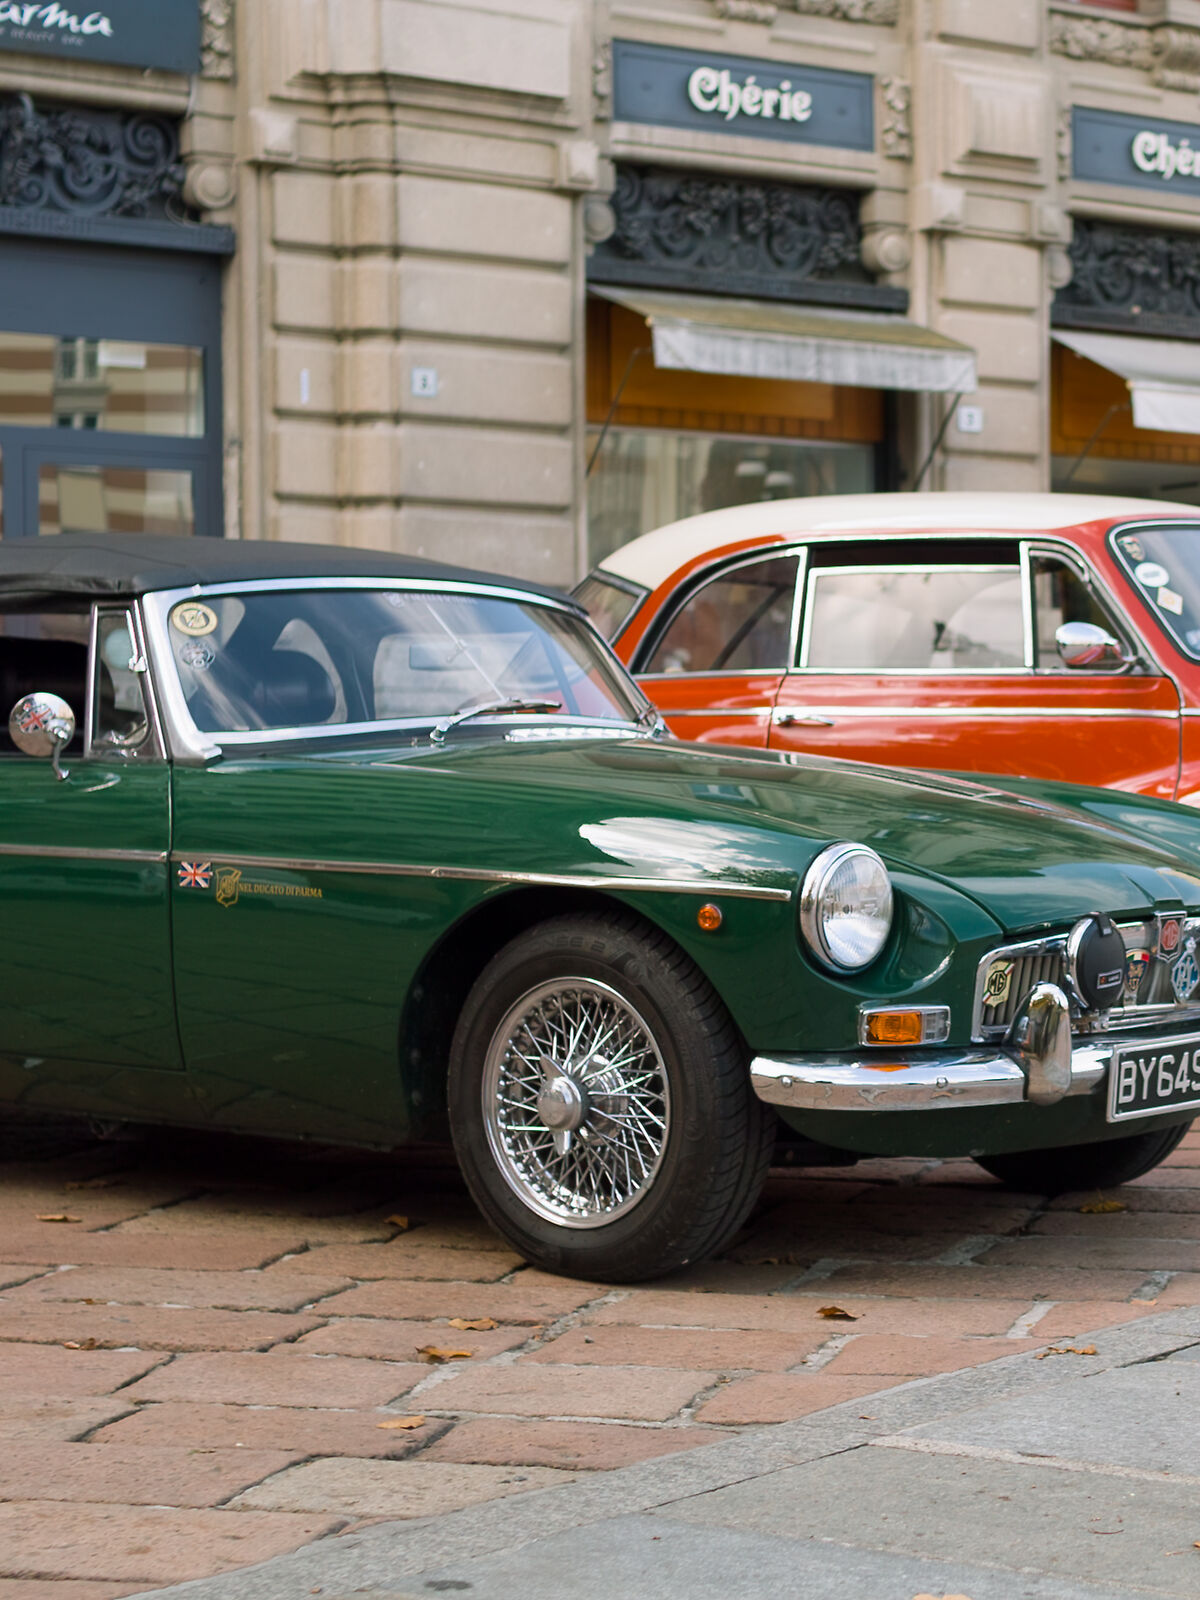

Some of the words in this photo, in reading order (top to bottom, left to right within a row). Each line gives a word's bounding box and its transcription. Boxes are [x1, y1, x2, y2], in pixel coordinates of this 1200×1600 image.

[688, 66, 812, 122] Chérie
[254, 884, 285, 896] DUCATO
[295, 886, 323, 898] PARMA
[989, 972, 1006, 993] MG
